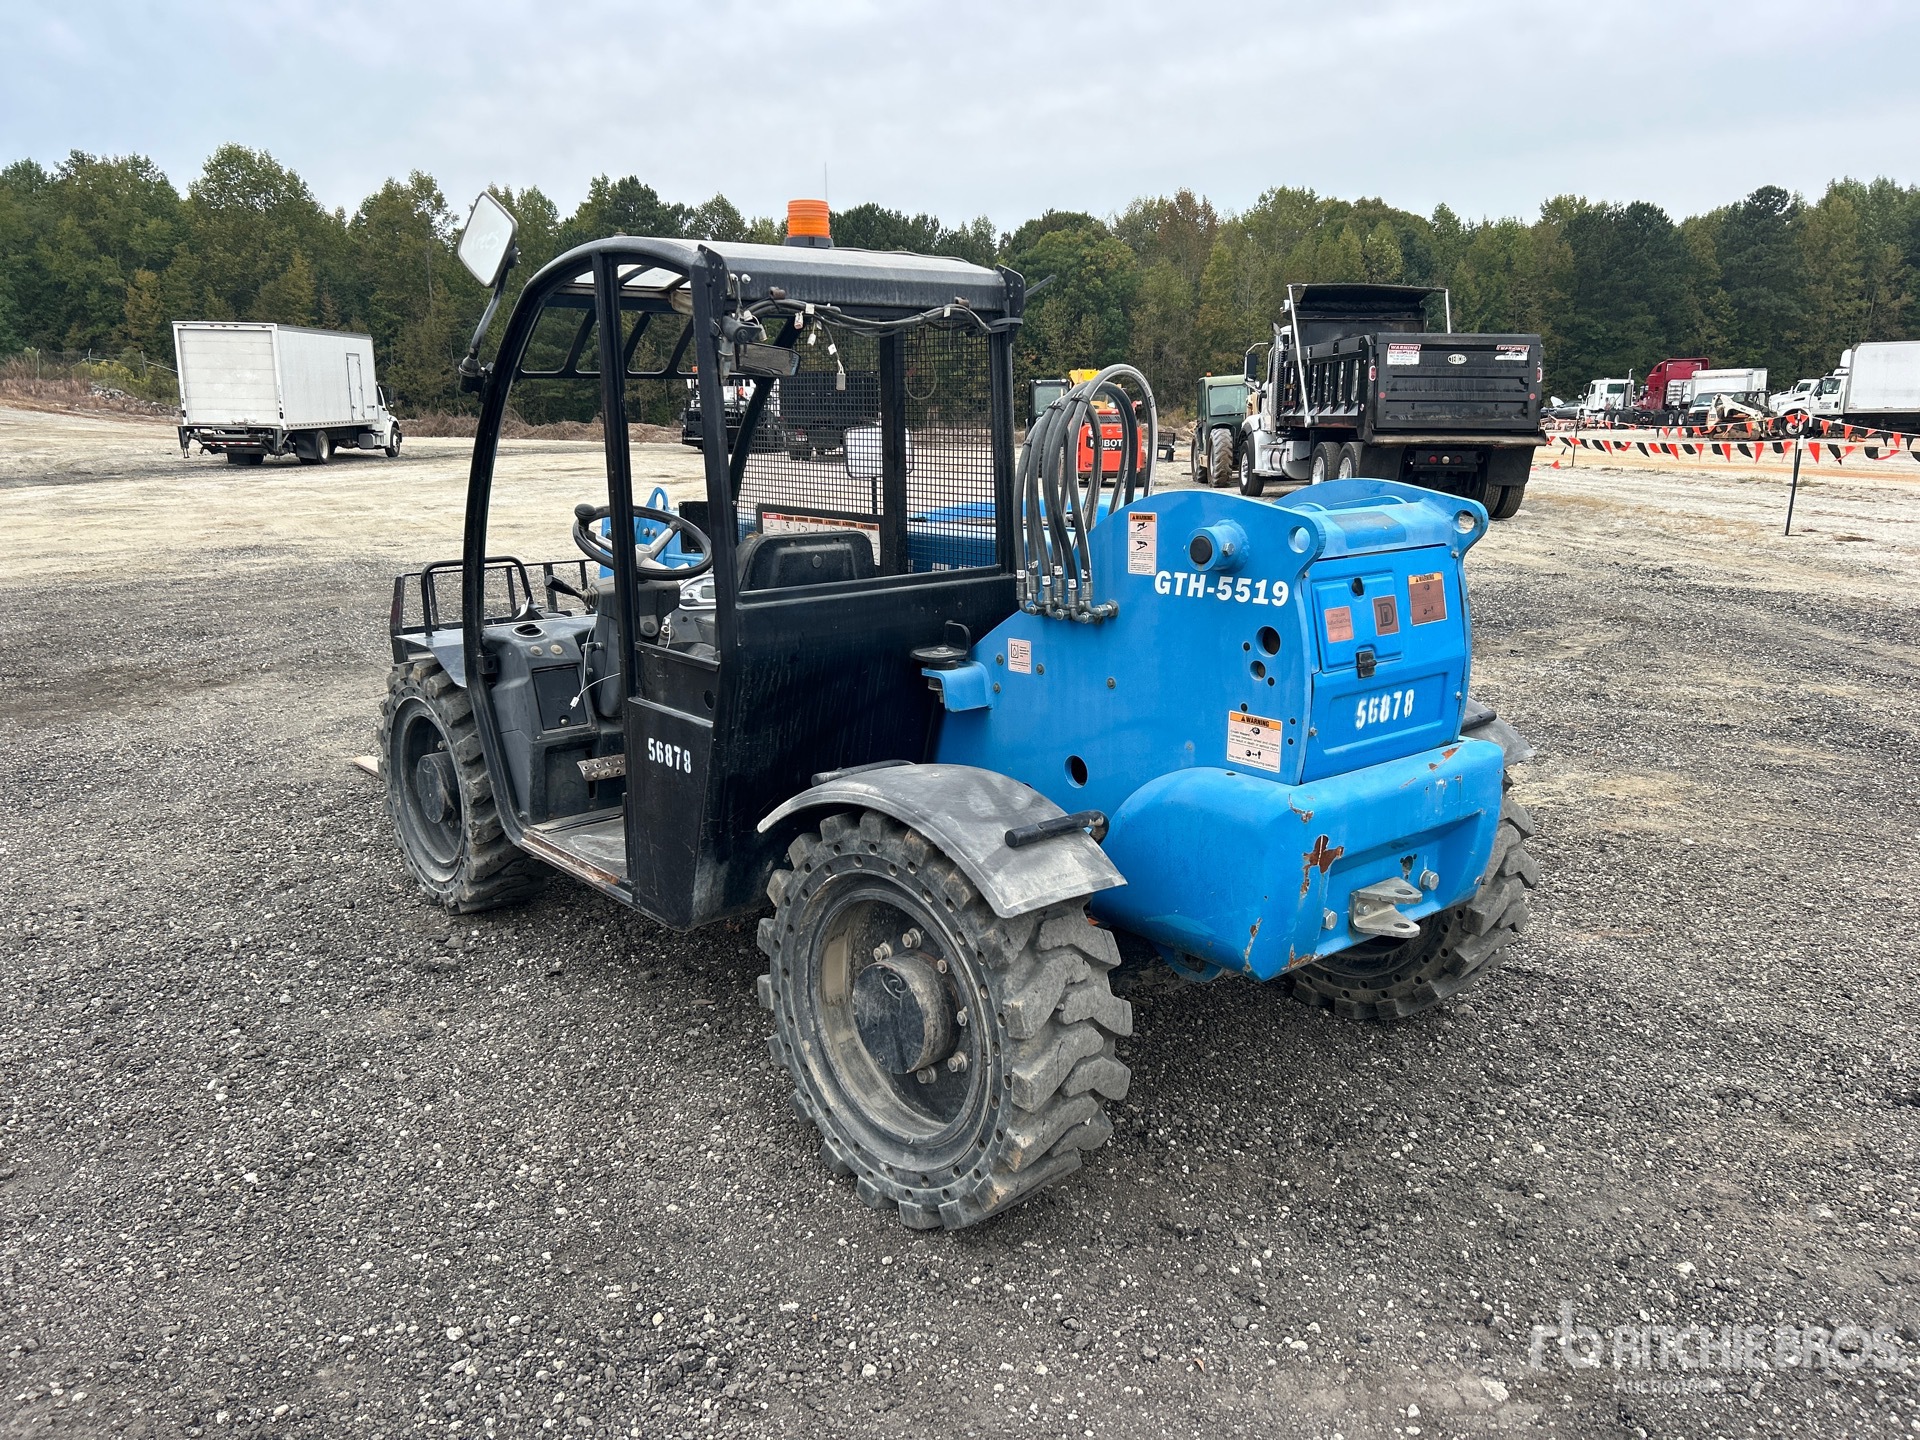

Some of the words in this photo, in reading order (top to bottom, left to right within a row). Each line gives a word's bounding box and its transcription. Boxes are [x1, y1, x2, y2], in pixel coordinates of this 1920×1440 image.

[1154, 570, 1289, 607] GTH-5519
[1246, 716, 1270, 728] WARNING
[1355, 689, 1415, 730] 56878
[648, 737, 692, 774] 56878
